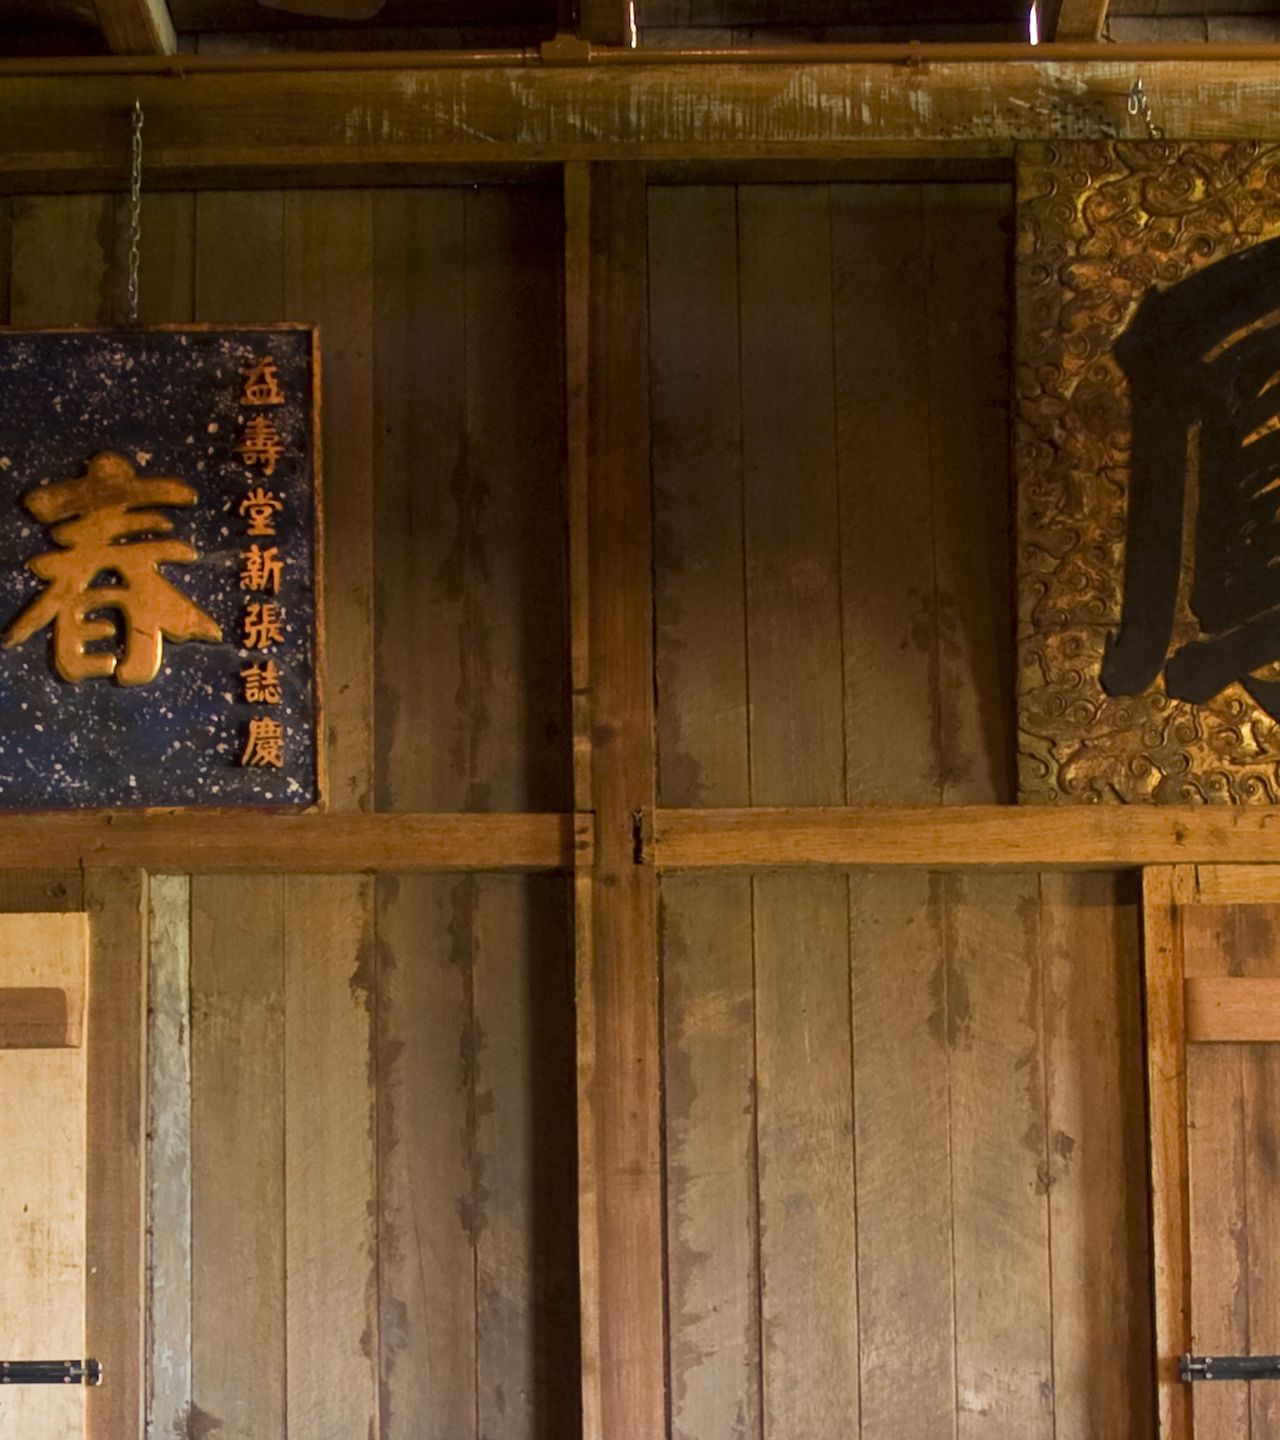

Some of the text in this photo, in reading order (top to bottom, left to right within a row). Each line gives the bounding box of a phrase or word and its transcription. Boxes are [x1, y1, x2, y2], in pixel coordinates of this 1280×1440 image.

[239, 357, 286, 770] 益壽堂新張誌慶
